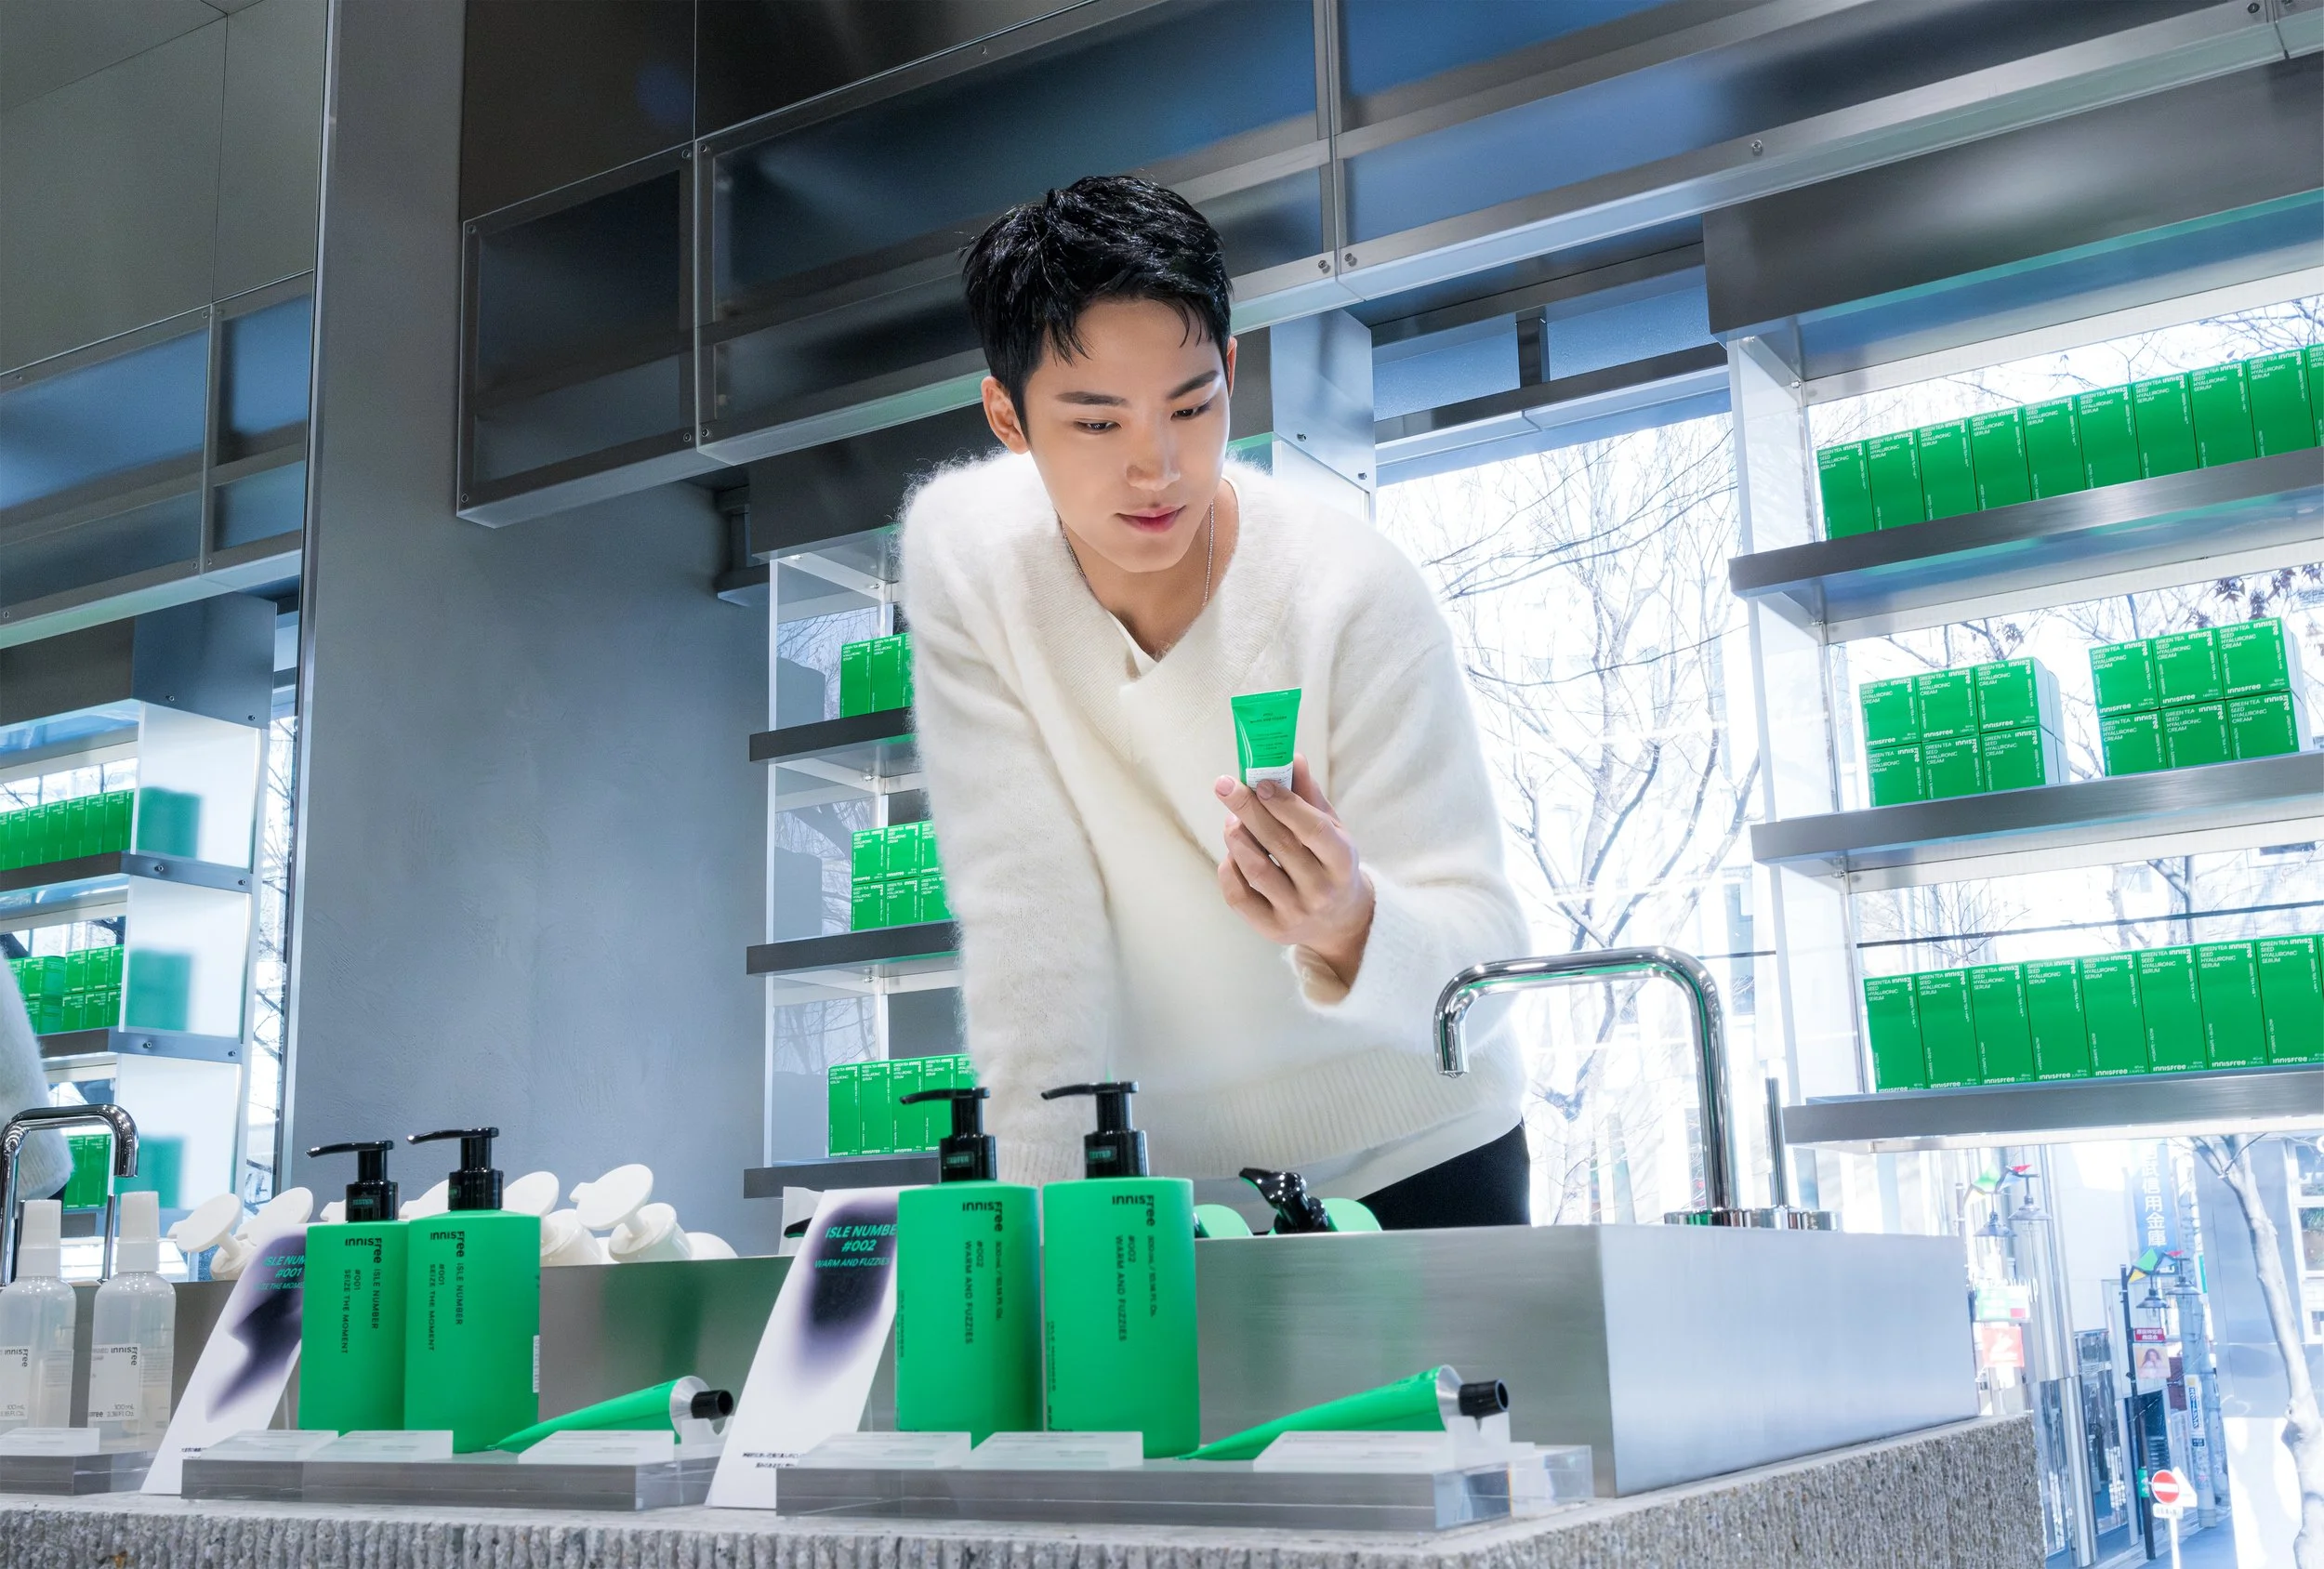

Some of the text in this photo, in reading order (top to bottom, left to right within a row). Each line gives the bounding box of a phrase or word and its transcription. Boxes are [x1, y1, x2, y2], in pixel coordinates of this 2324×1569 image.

[2141, 1146, 2167, 1246] 武信用金庫
[825, 1226, 852, 1238] ISLE
[841, 1239, 877, 1252] #002
[1128, 1235, 1136, 1263] #002
[275, 1268, 303, 1278] #001
[814, 1257, 891, 1268] WARM AND FUZZIES
[371, 1269, 381, 1329] ISLE NUMBER
[456, 1262, 464, 1325] ISLE NUMBER
[1116, 1235, 1127, 1341] WARM AND FUZZIES
[341, 1314, 350, 1353] MOMENT
[965, 1302, 973, 1344] FUZZIES
